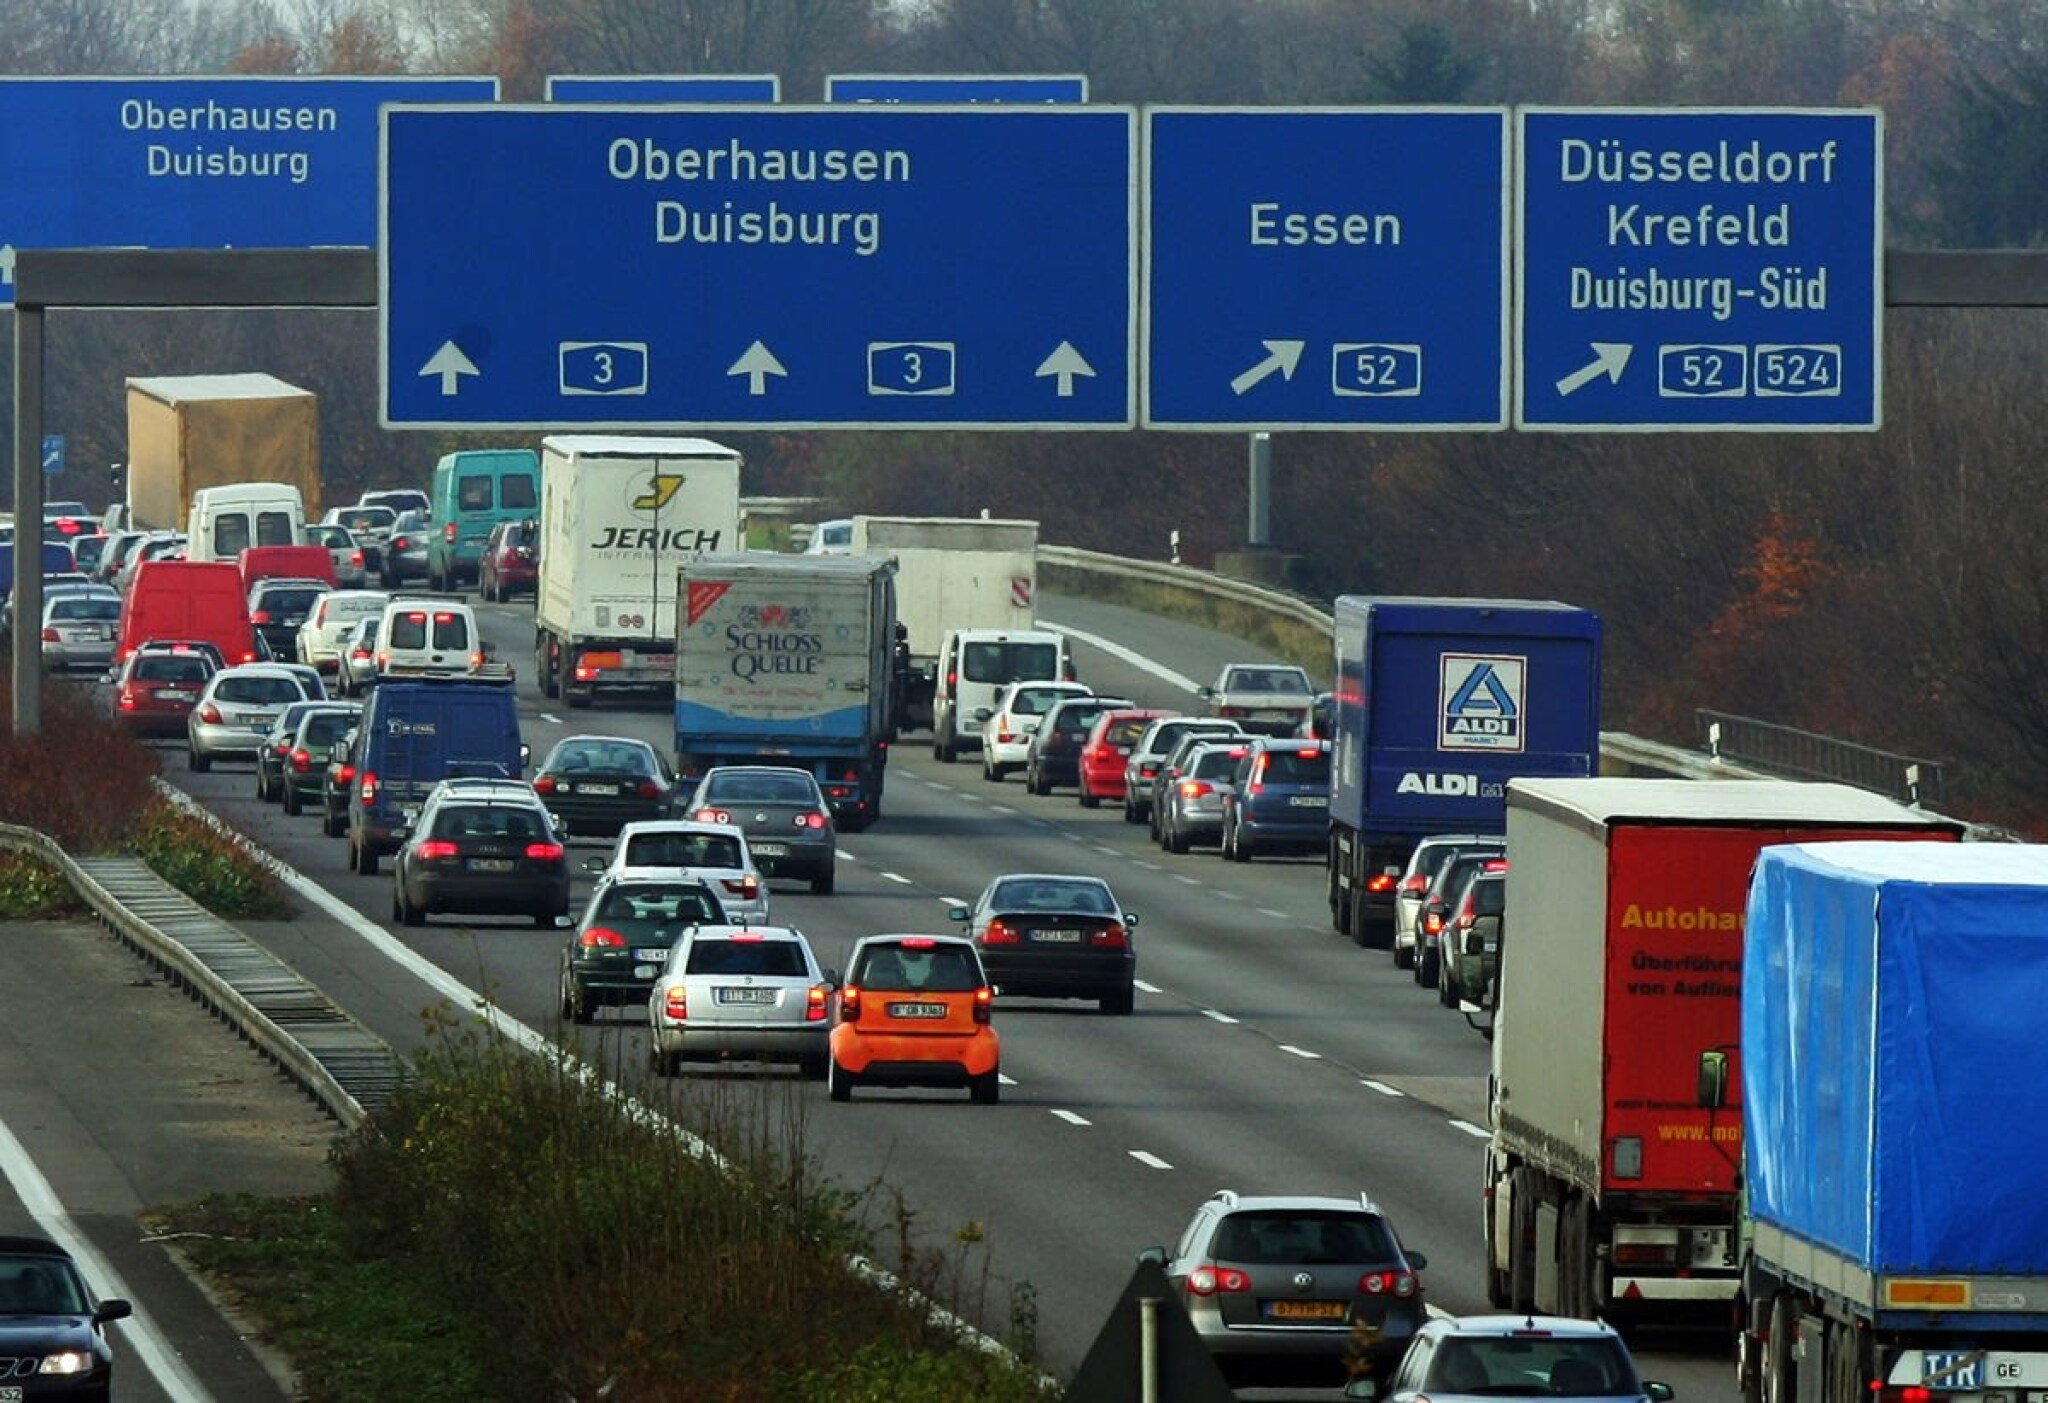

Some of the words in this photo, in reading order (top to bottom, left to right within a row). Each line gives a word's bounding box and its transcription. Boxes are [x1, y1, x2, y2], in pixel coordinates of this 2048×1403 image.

[121, 99, 336, 131] Oberhausen
[148, 145, 309, 183] Duisburg
[608, 137, 909, 181] Oberhausen
[1562, 139, 1836, 183] Düsseldorf
[656, 201, 879, 255] Duisburg
[1251, 203, 1400, 245] Essen
[1608, 205, 1788, 246] Krefeld
[1571, 267, 1826, 320] Duisburg-Süd
[594, 352, 612, 383] 3
[904, 352, 921, 384] 3
[1357, 354, 1397, 385] 52
[1683, 354, 1723, 387] 52
[1767, 354, 1829, 385] 524
[591, 527, 721, 551] JERICH
[1451, 718, 1510, 735] ALDI
[1396, 772, 1478, 797] ALDI
[1627, 982, 1665, 996] von
[1926, 1354, 1977, 1386] TIR
[1996, 1363, 2021, 1379] GE
